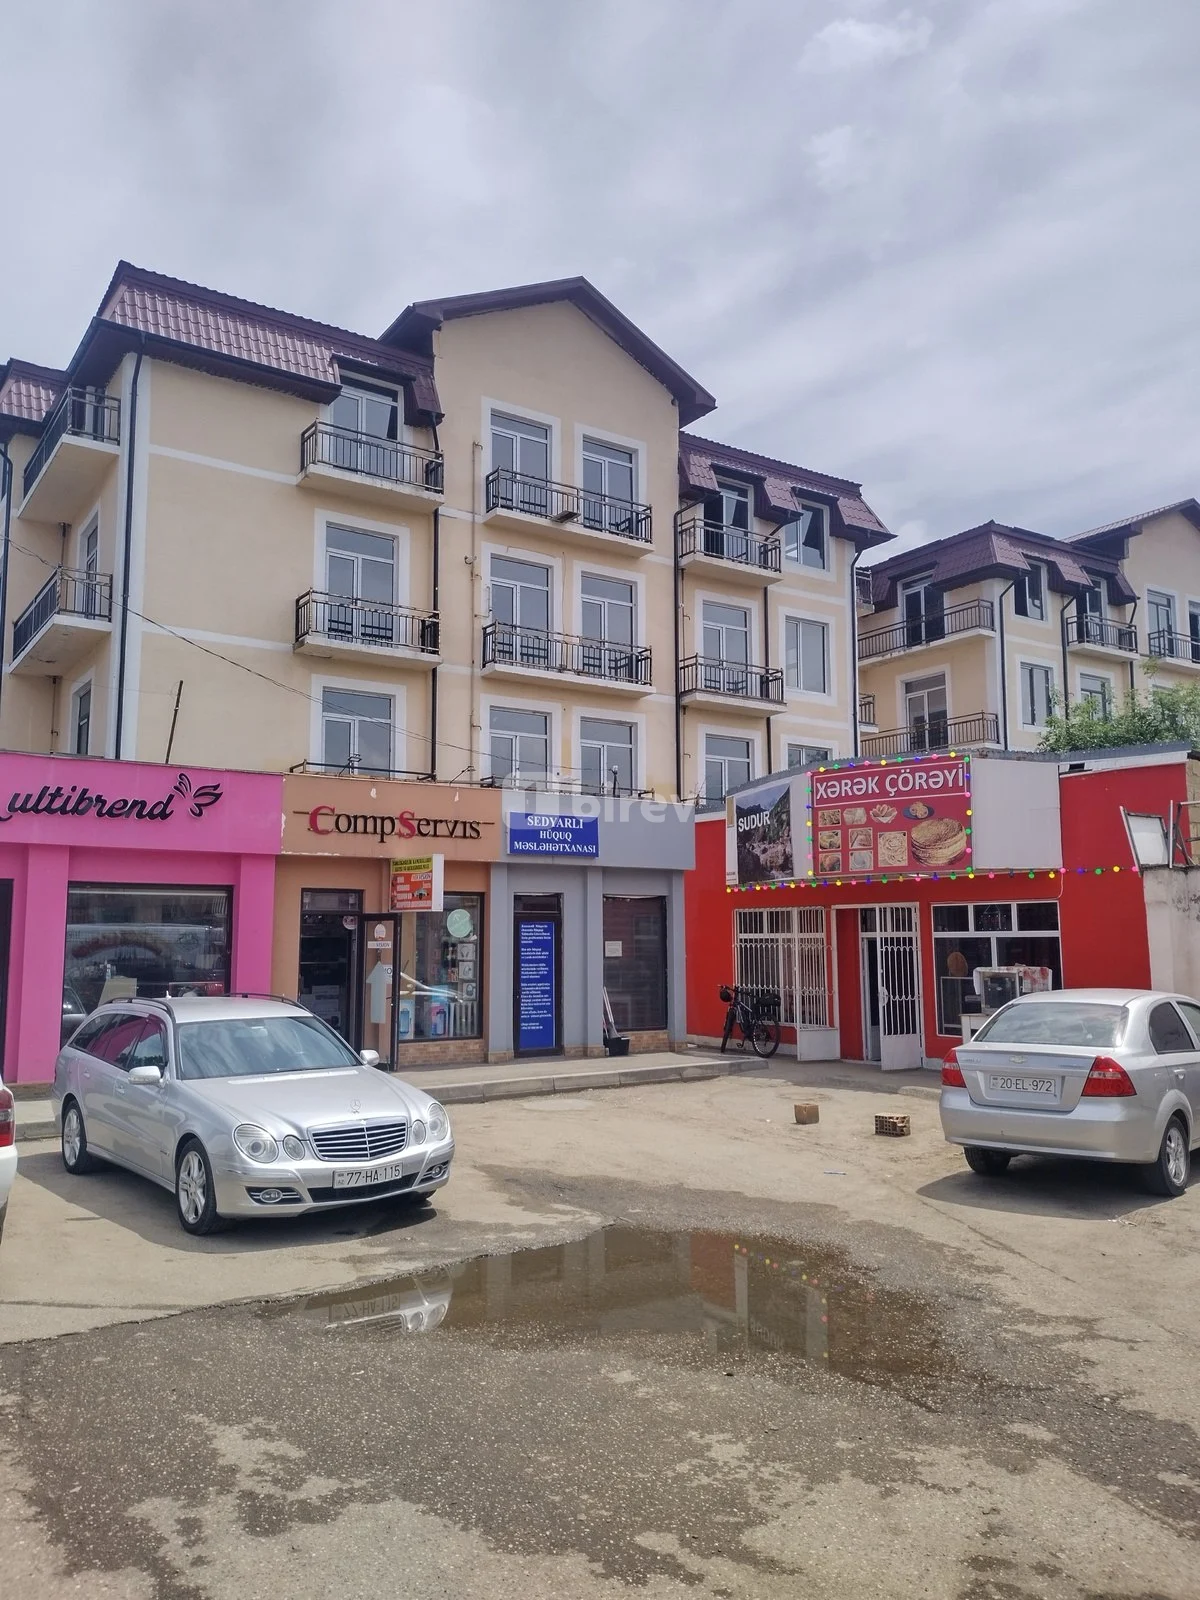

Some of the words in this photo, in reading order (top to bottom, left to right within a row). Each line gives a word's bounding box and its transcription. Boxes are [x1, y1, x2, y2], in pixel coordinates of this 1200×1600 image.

[816, 776, 880, 800] XƏRƏK
[885, 763, 964, 797] ÇÖRƏYİ
[0, 785, 175, 822] ultibrend
[527, 815, 584, 830] SEDYARLI
[738, 811, 771, 833] SUDUR
[540, 830, 573, 842] HÜQUQ
[513, 841, 596, 854] MƏSLƏHƏTXANASI
[346, 1164, 401, 1186] 77-HA-115
